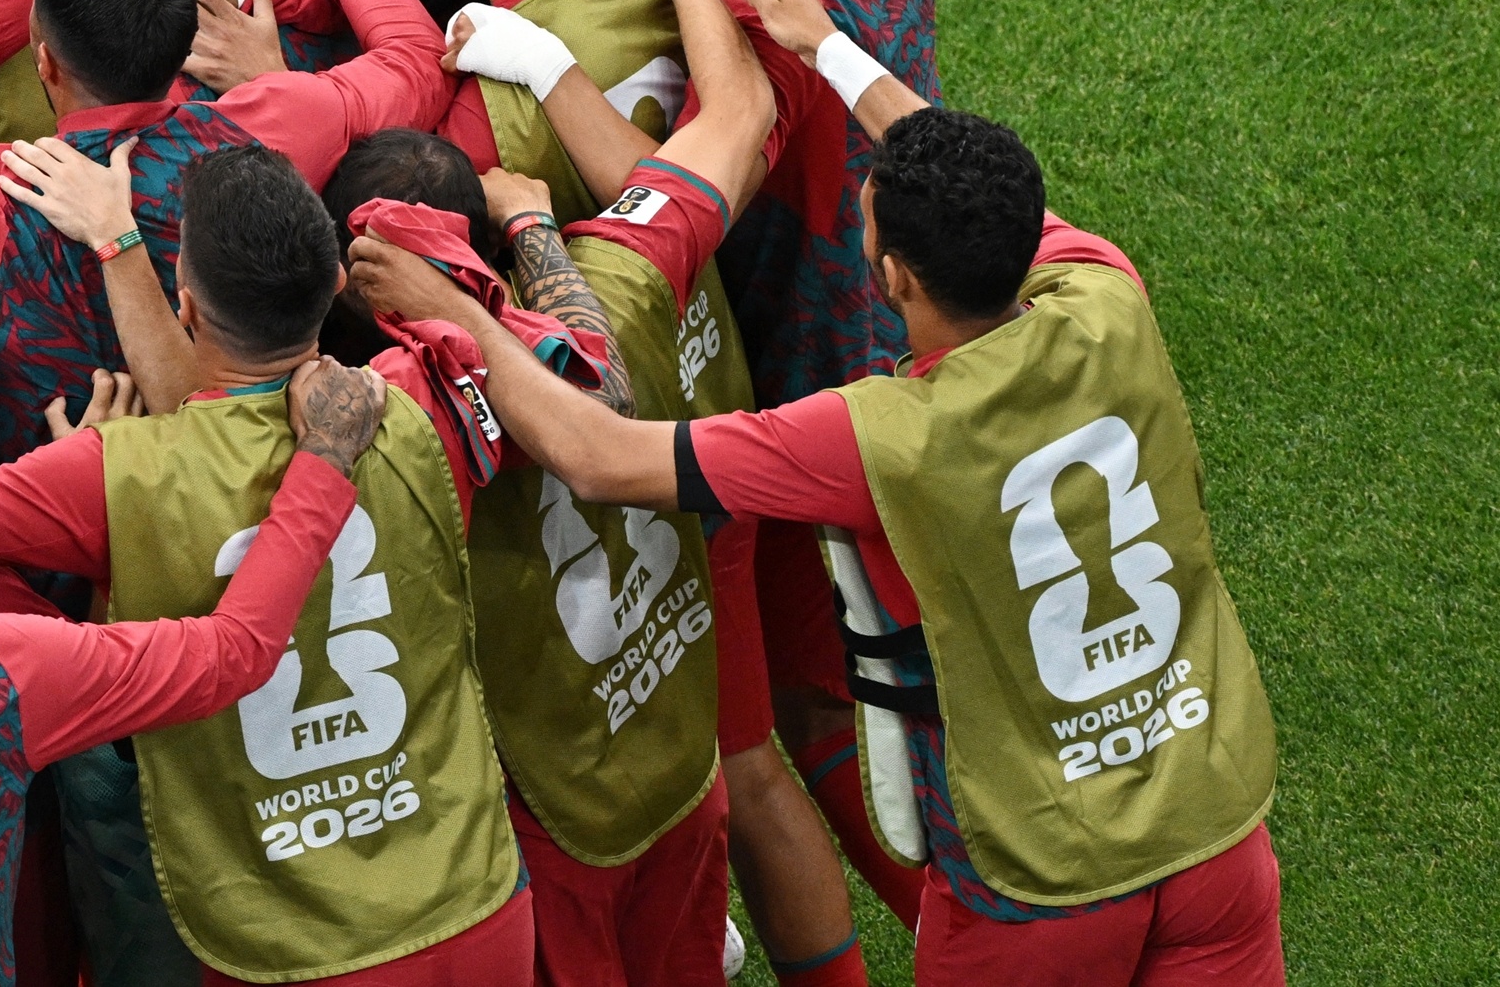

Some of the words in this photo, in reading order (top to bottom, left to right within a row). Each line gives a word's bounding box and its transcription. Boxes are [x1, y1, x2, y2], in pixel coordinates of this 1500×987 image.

[686, 289, 709, 328] CUP
[612, 565, 652, 631] FIFA
[592, 620, 657, 702] WORLD
[656, 577, 699, 624] CUP
[607, 600, 712, 736] 2026
[1082, 623, 1156, 672] FIFA
[291, 709, 369, 752] FIFA
[1050, 689, 1154, 741] WORLD
[1155, 658, 1192, 700] CUP
[1058, 686, 1210, 783] 2026
[255, 774, 360, 821] WORLD
[364, 751, 408, 791] CUP
[261, 779, 421, 862] 2026
